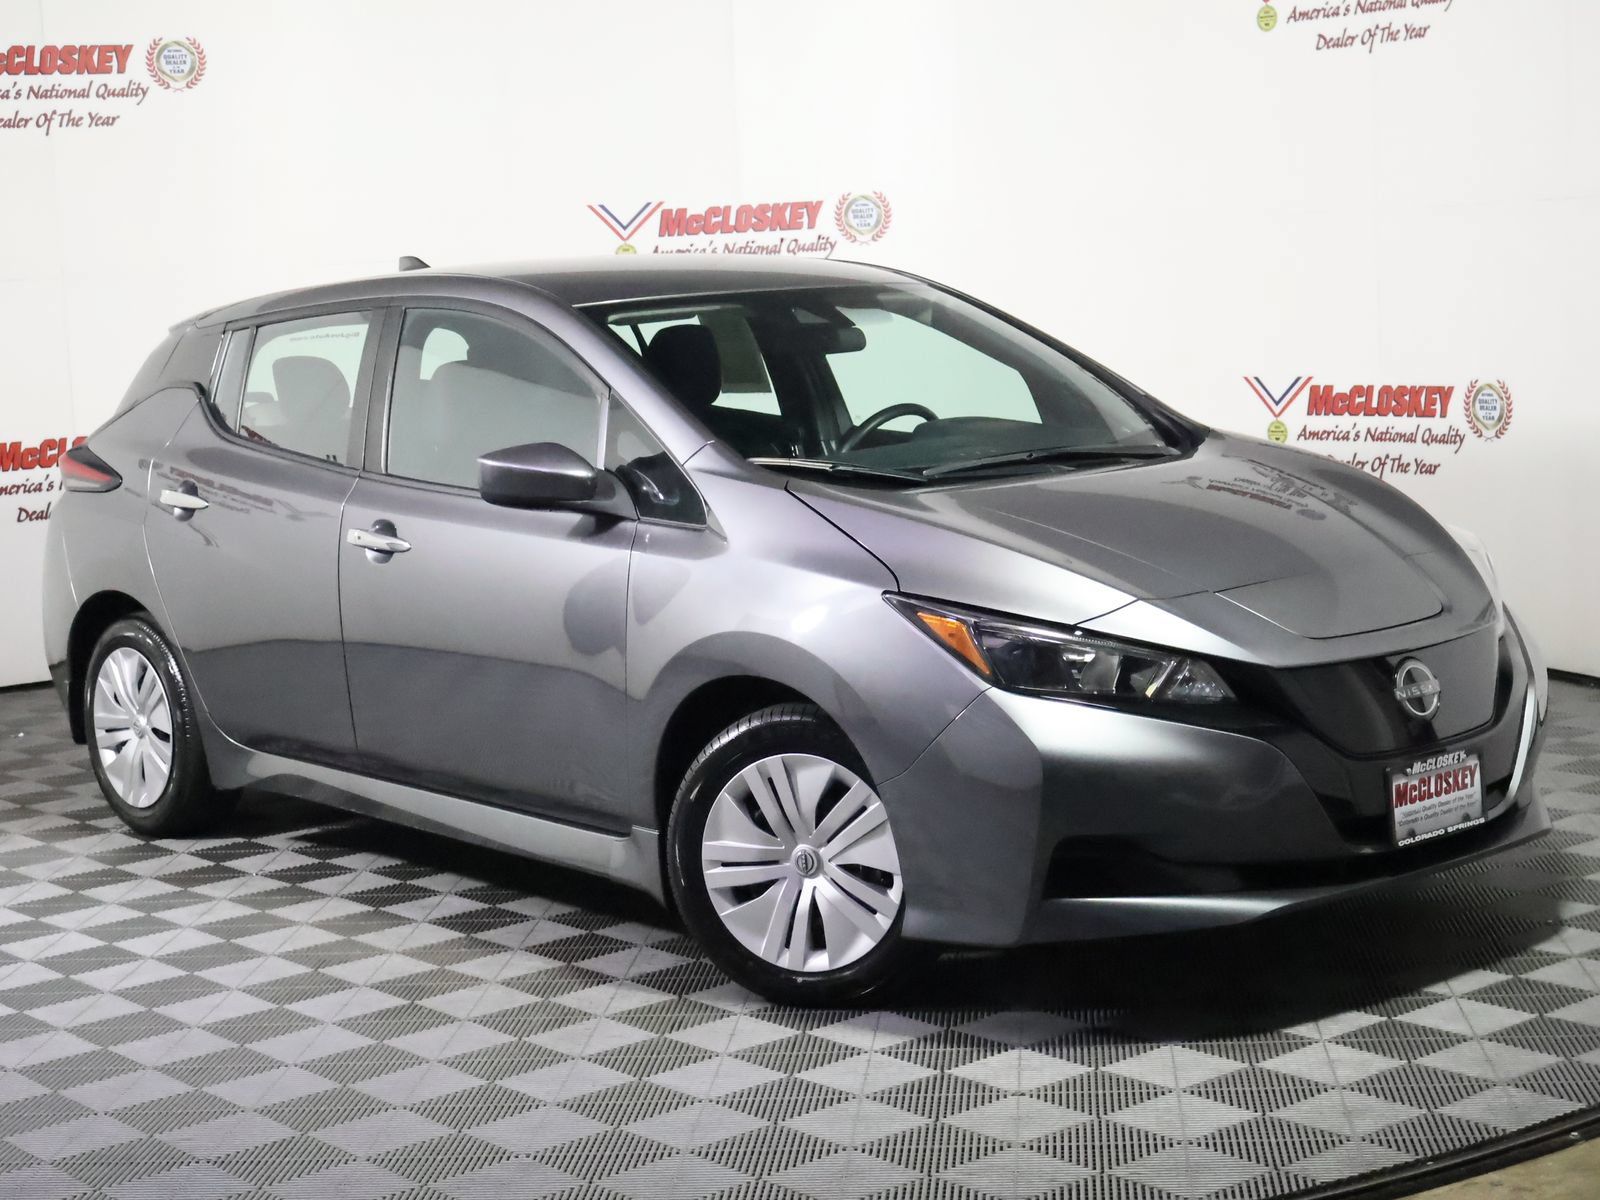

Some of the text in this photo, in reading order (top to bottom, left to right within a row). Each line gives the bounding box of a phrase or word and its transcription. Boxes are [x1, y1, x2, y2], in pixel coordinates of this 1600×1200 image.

[1287, 0, 1351, 23] America's
[1316, 22, 1431, 53] Dealer Of The Year
[27, 80, 94, 100] National
[95, 80, 149, 106] Quality
[36, 109, 57, 136] Of
[58, 109, 83, 127] The
[88, 112, 120, 128] Year
[658, 200, 824, 237] McCLOSKEY
[722, 238, 784, 256] National
[786, 234, 837, 260] Quality
[1307, 384, 1454, 418] McCLOSKEY
[1297, 423, 1360, 442] America's
[1364, 424, 1417, 444] National
[1421, 424, 1465, 454] Quality
[1371, 453, 1389, 480] Of
[1390, 454, 1410, 473] The
[1414, 458, 1440, 475] Year
[1411, 750, 1467, 775] McCLOSKEY
[1394, 763, 1478, 808] McCLOSKEY
[1398, 817, 1486, 847] COLORADO SPRINGS
